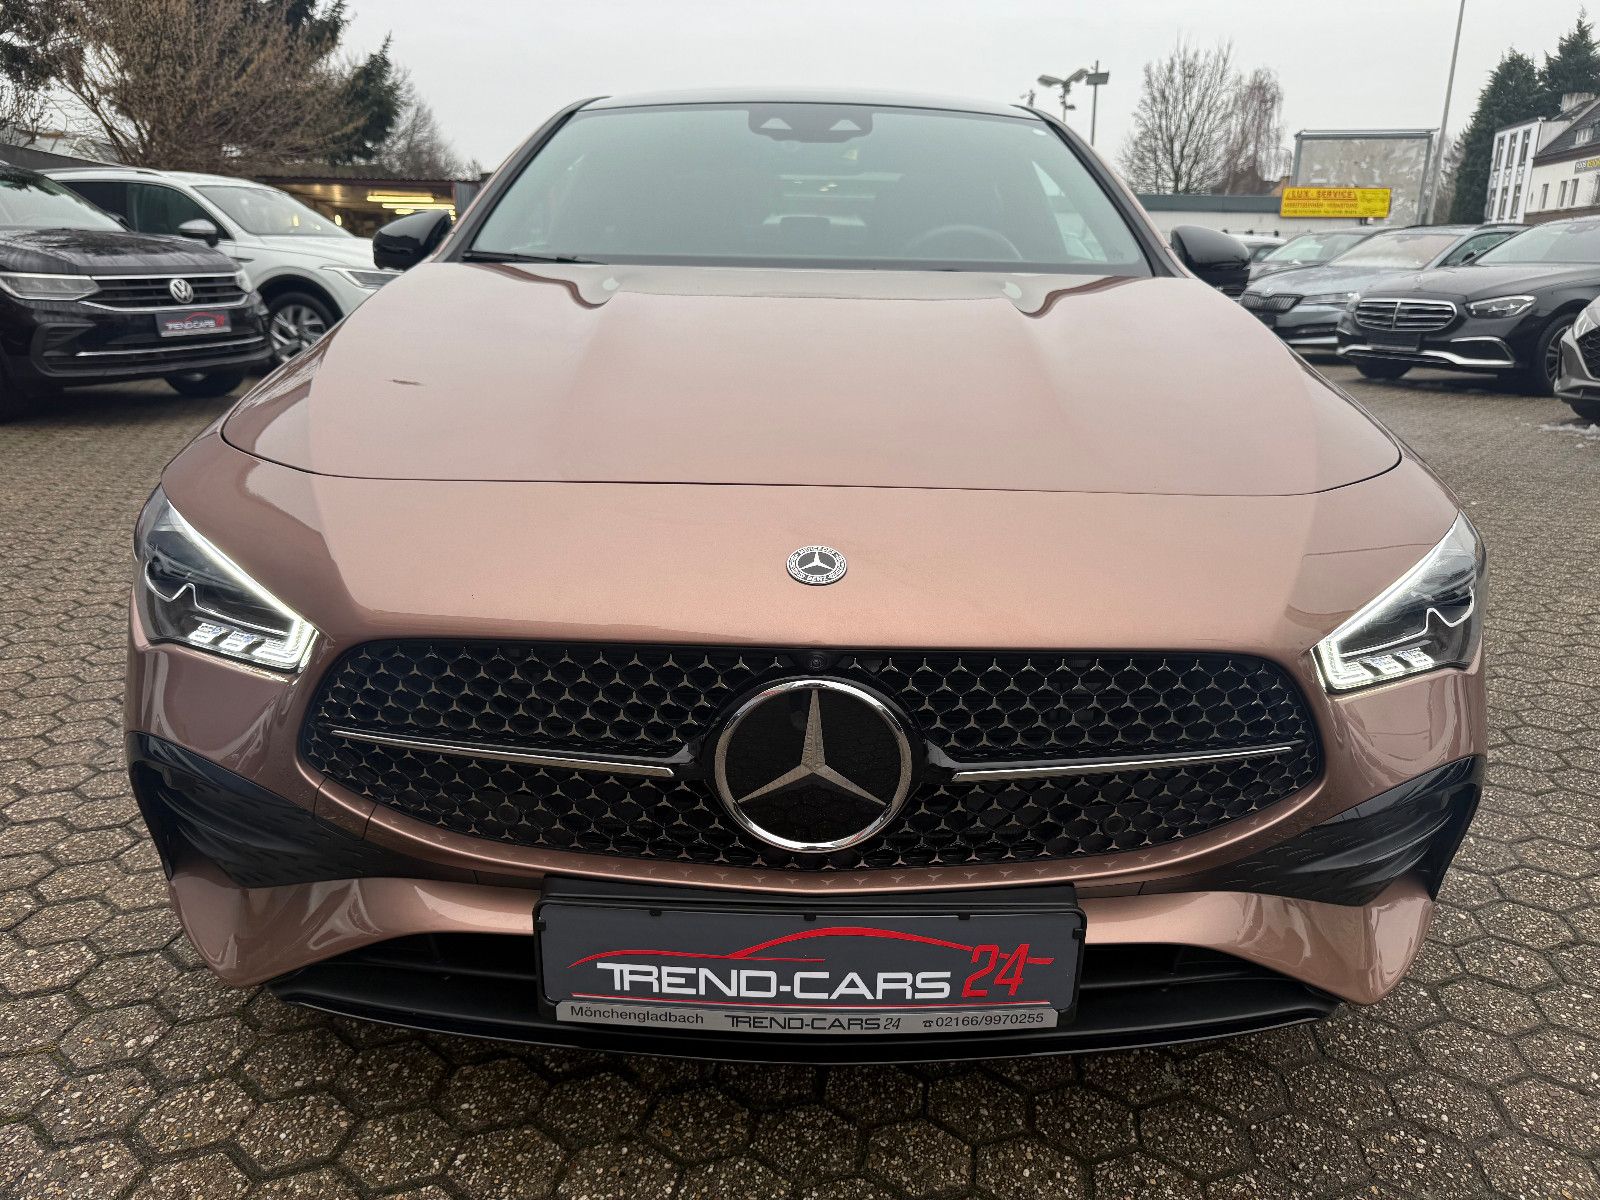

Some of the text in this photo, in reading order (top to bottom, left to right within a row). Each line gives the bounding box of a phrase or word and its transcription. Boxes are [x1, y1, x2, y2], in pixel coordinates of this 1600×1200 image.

[1317, 190, 1353, 199] SERVICE
[597, 943, 1030, 999] TREND-CARS 24
[570, 1005, 1044, 1031] Mönchengladbach TREND-CARS 24 02166/9970255
